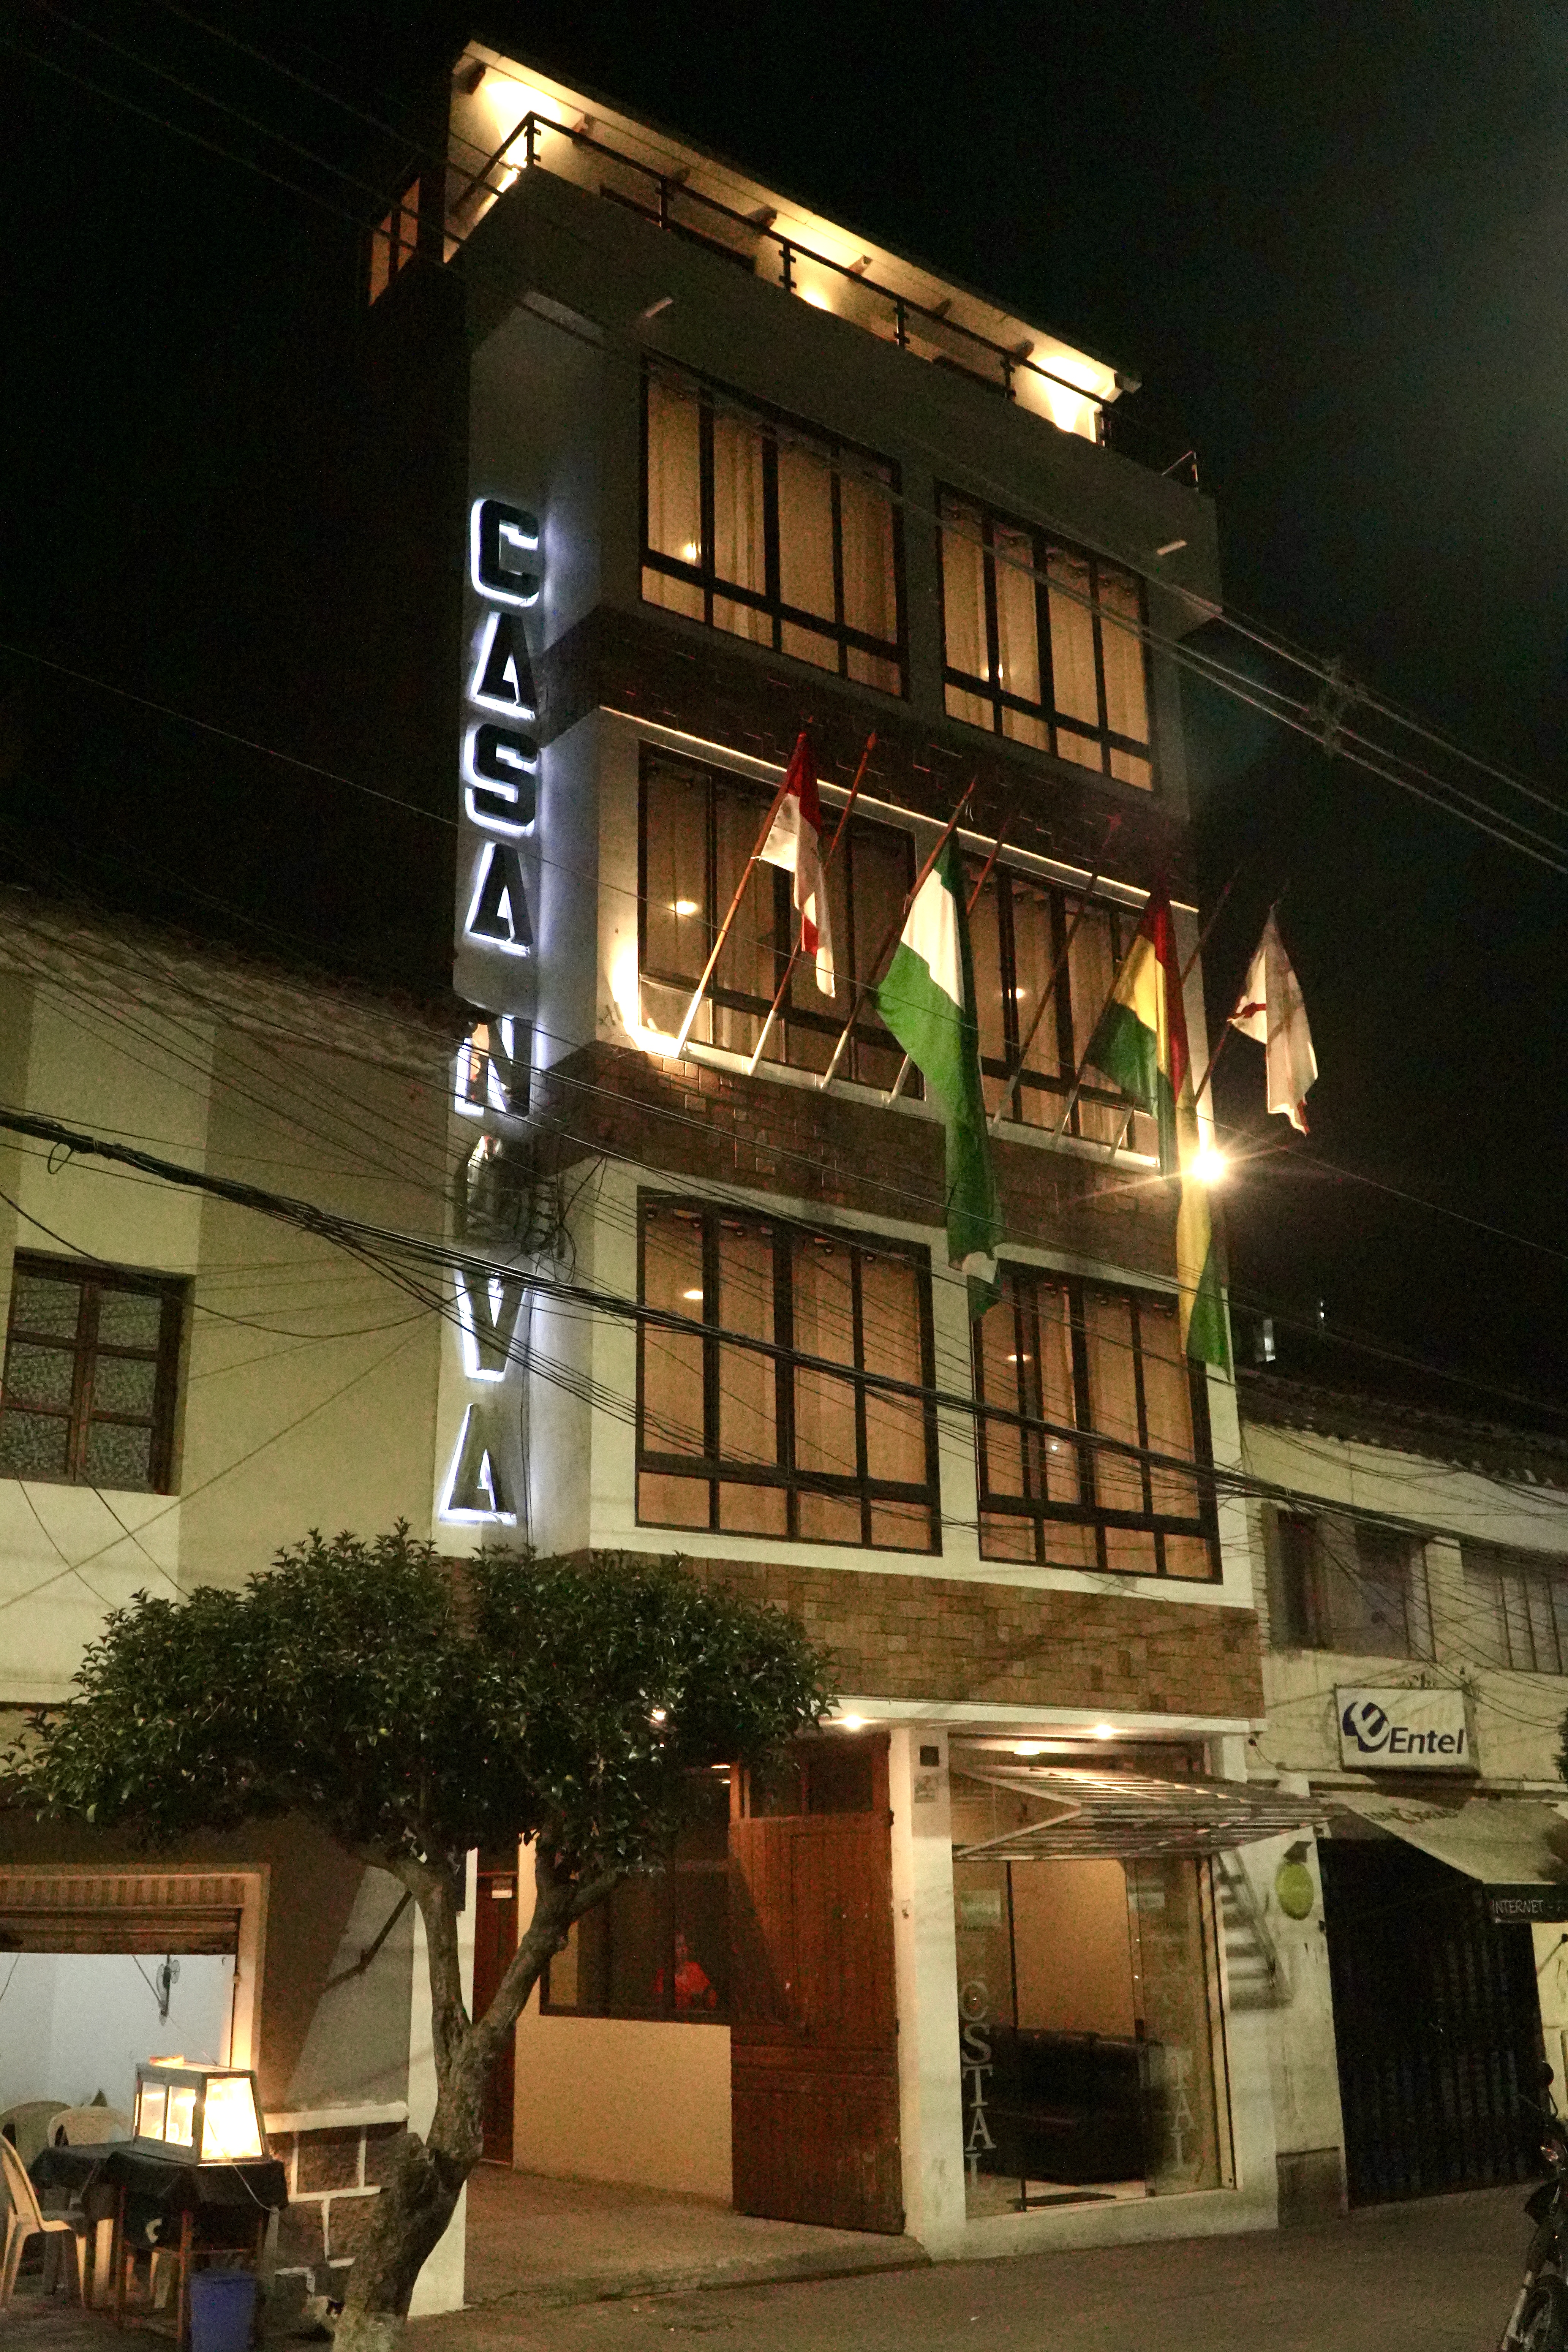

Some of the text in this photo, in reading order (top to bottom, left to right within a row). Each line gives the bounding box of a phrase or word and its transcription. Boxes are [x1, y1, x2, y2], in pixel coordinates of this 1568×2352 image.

[463, 498, 539, 956] CASA
[1389, 1727, 1464, 1755] Entel
[1490, 1900, 1544, 1914] INTERNET
